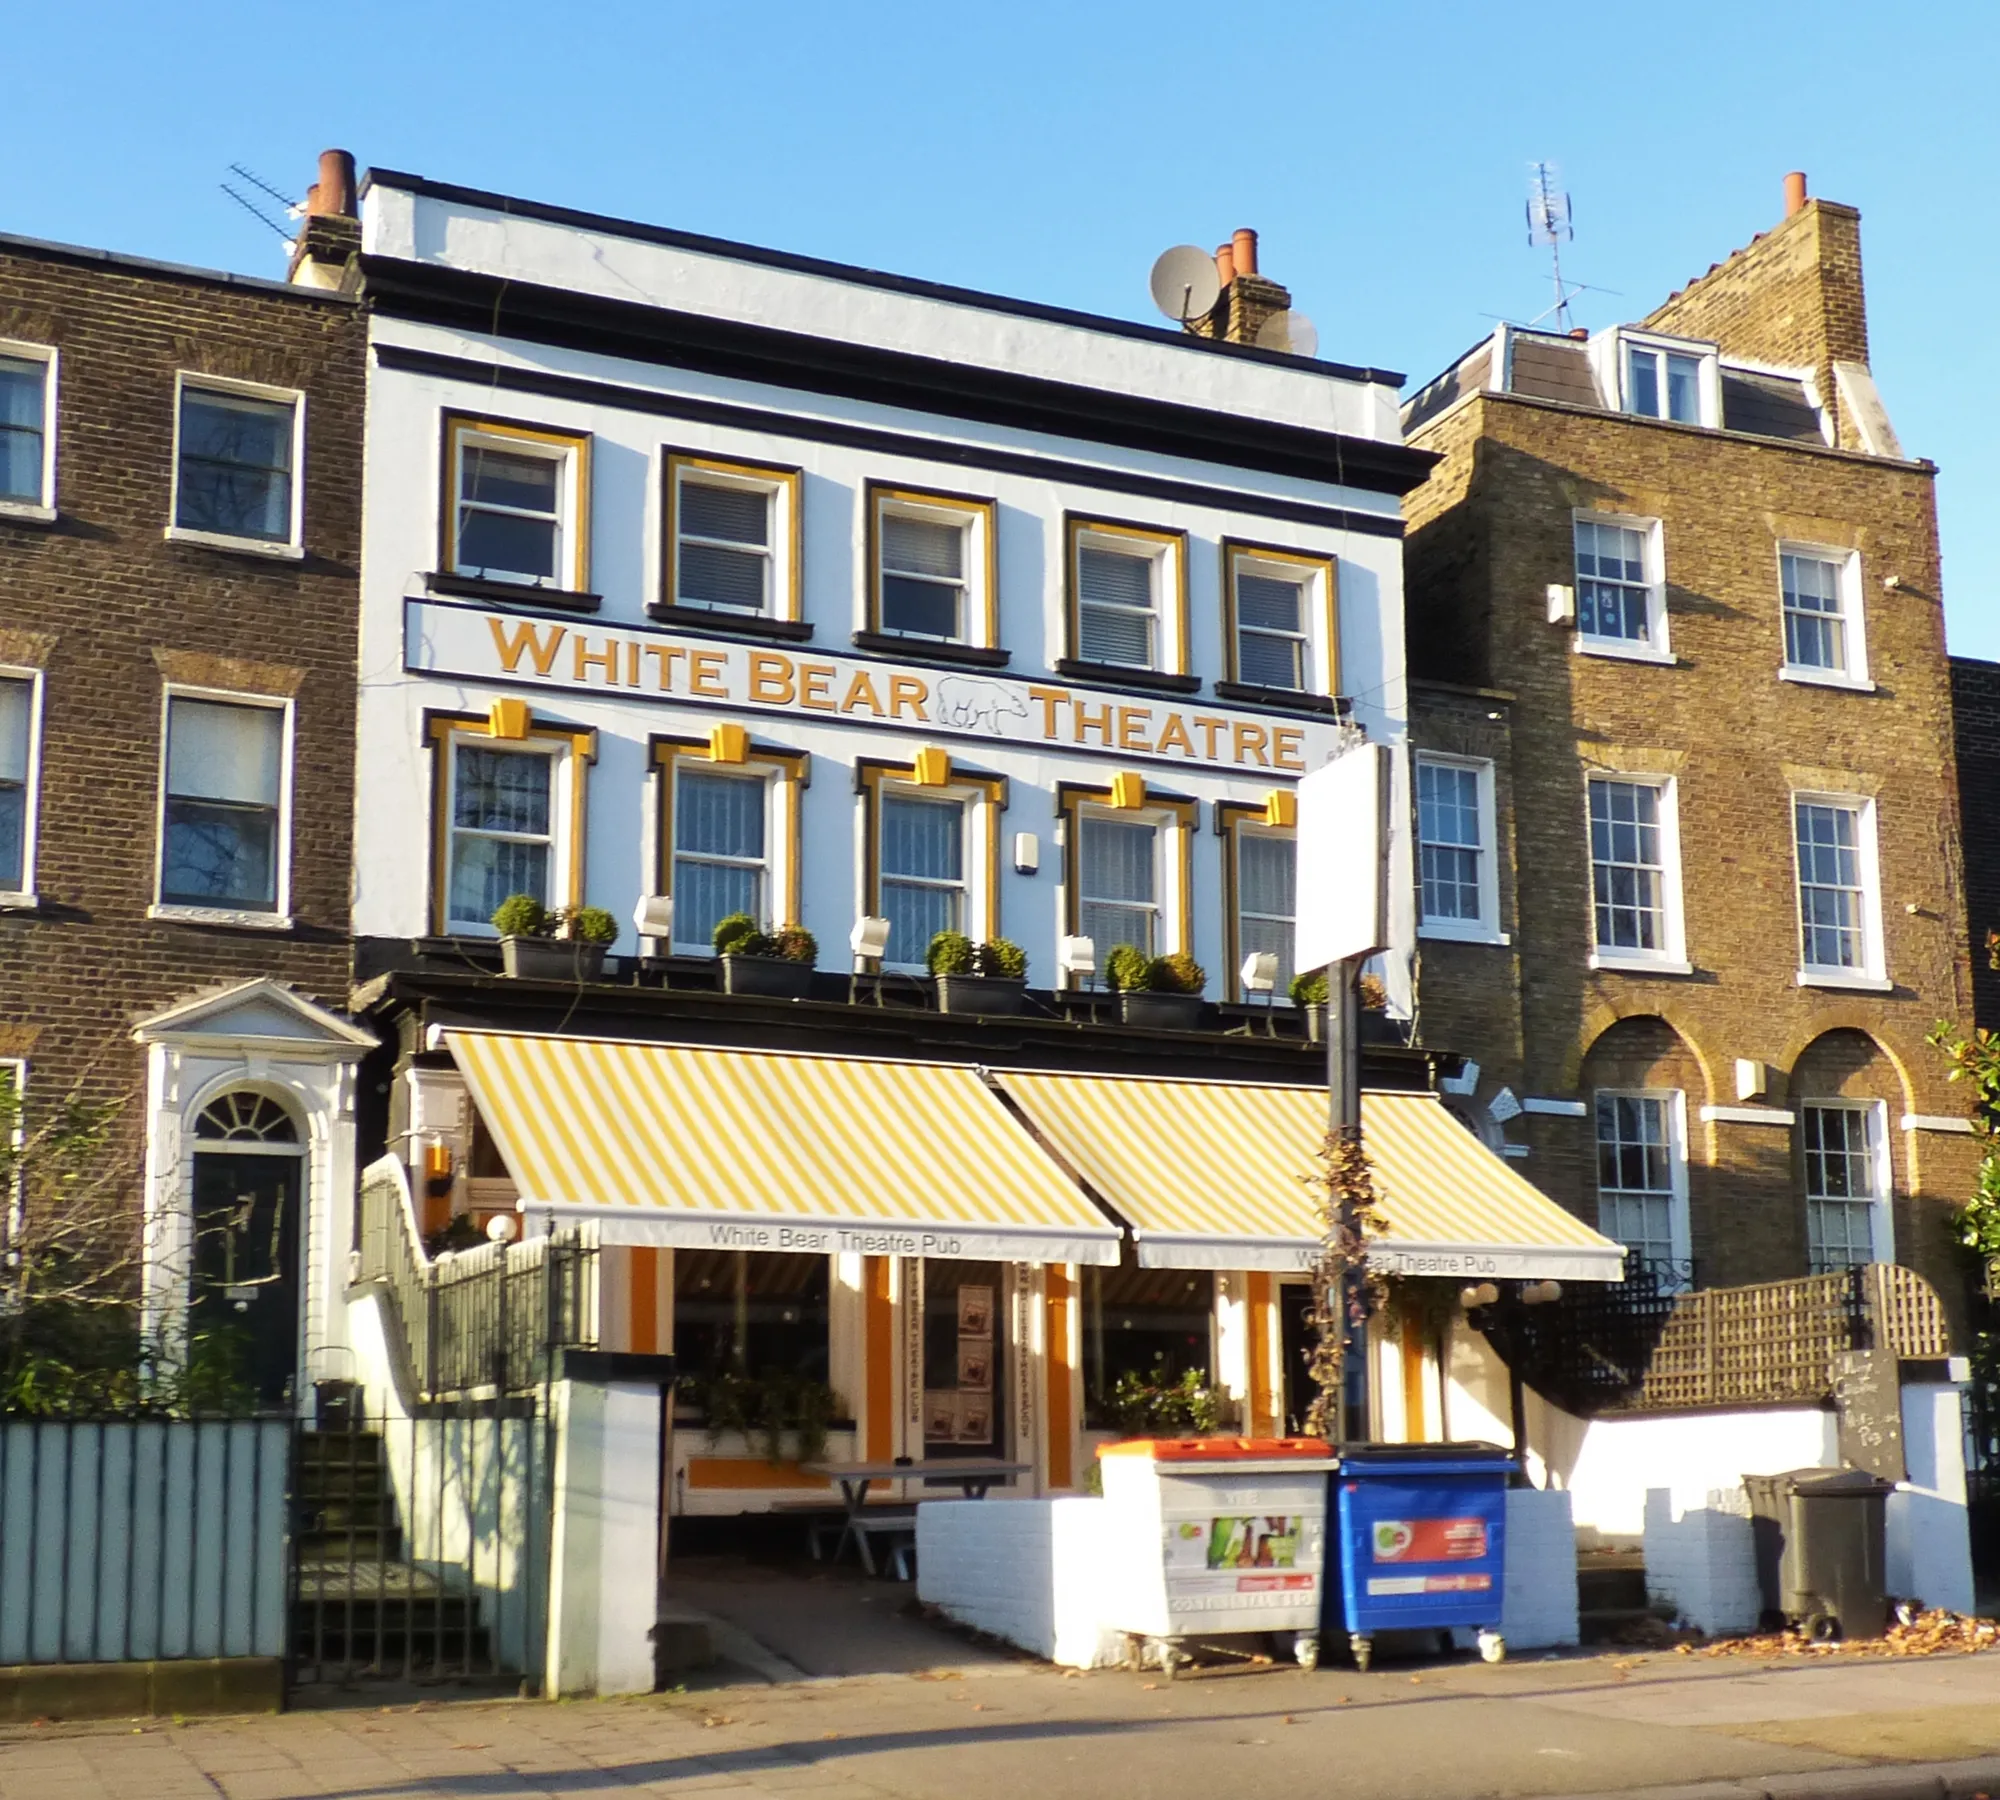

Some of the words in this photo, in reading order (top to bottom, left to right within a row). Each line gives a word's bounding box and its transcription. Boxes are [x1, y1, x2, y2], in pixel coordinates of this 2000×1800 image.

[485, 616, 730, 699] WHITE
[746, 650, 932, 723] BEAR
[1028, 686, 1307, 771] THEATRE
[708, 1225, 769, 1246] White
[778, 1228, 828, 1249] Bear
[837, 1231, 916, 1253] Theatre
[921, 1234, 962, 1255] Pub
[1395, 1253, 1460, 1273] Theatre
[1464, 1255, 1497, 1274] Pub
